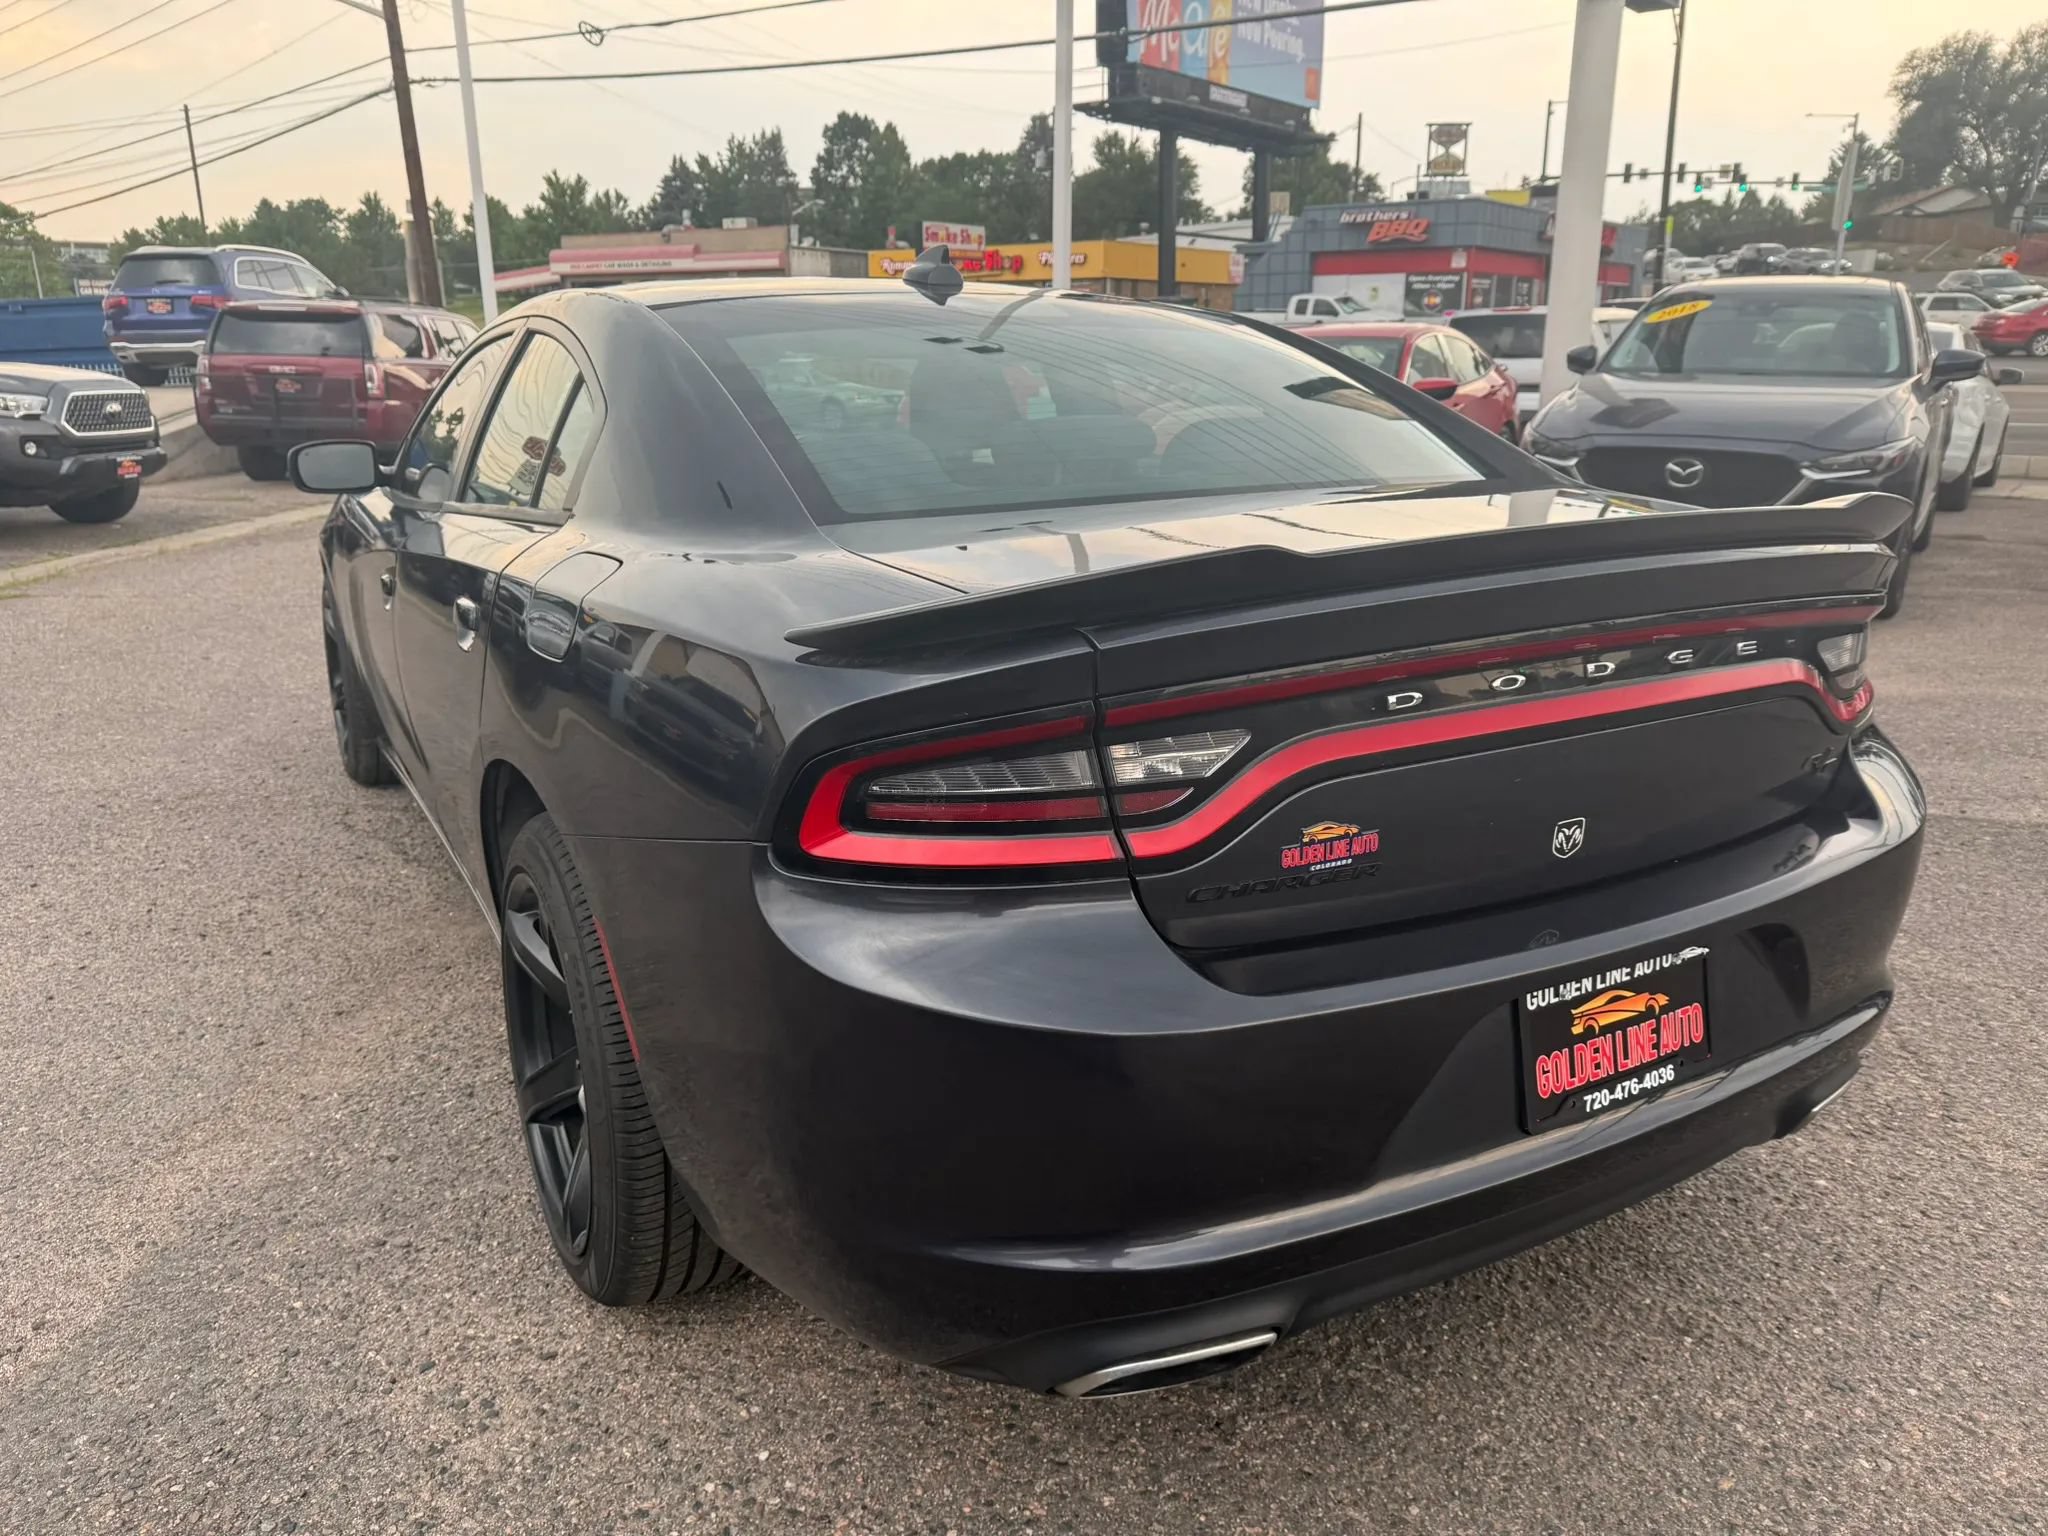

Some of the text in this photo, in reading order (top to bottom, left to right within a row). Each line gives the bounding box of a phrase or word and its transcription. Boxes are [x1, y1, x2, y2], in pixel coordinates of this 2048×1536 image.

[1339, 208, 1409, 223] brothers
[1367, 218, 1430, 243] BBQ
[925, 225, 983, 250] Smoke Shop
[983, 248, 1022, 275] Shop
[80, 288, 93, 296] CAR
[1388, 640, 1757, 709] DODGE
[1281, 832, 1379, 869] GOLDEN LINE AUTO
[1310, 858, 1353, 871] COLORADO
[1186, 862, 1383, 904] CHARGER
[1526, 977, 1592, 1011] GOLDEN
[1596, 966, 1631, 990] LINE
[1536, 1002, 1704, 1099] GOLDEN LINE AUTO
[1583, 1064, 1675, 1112] 720-476-4036
